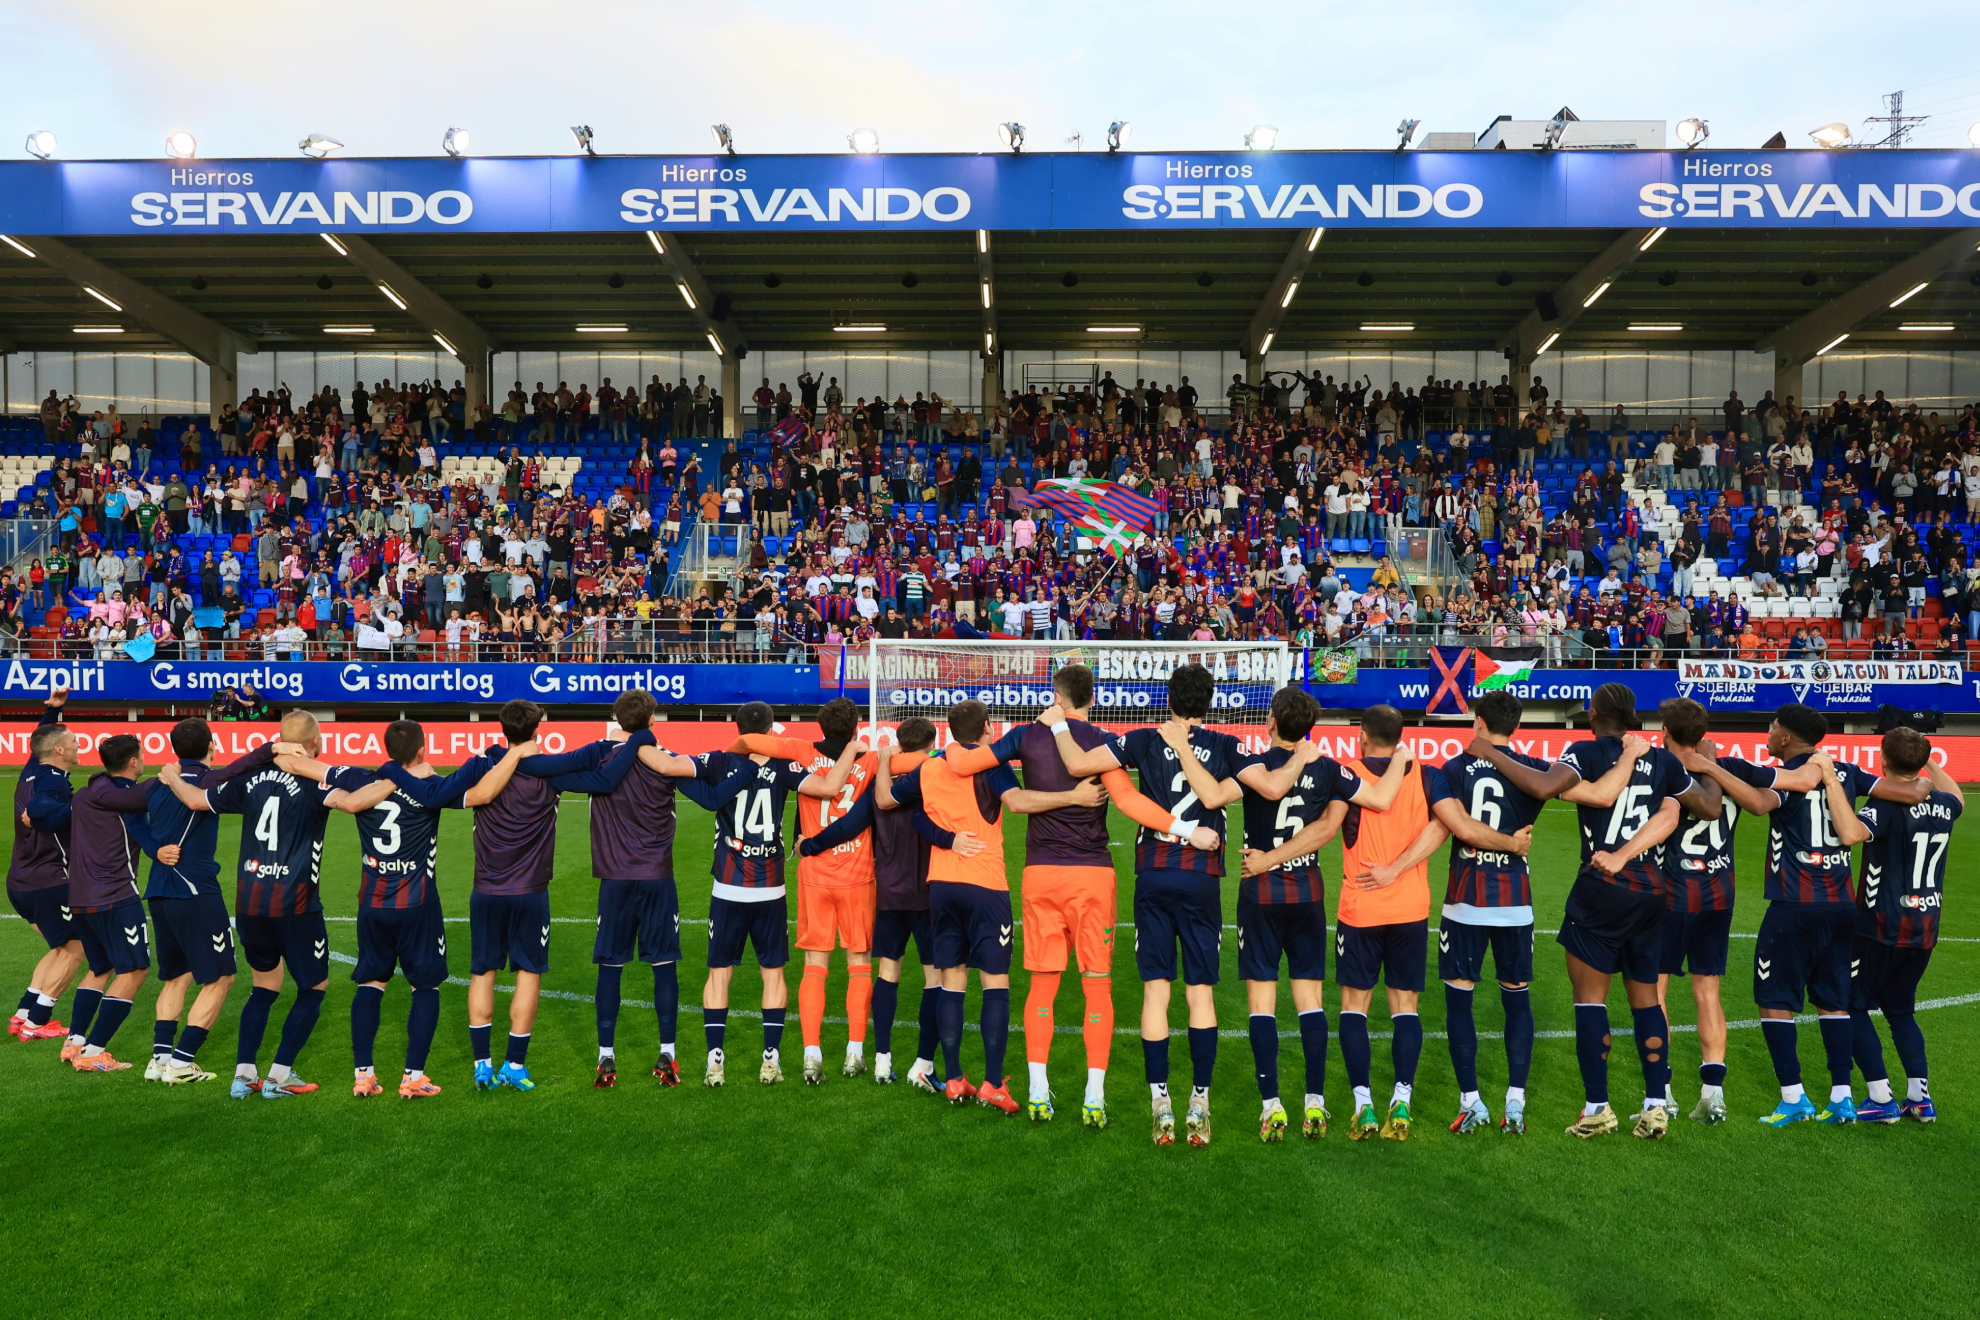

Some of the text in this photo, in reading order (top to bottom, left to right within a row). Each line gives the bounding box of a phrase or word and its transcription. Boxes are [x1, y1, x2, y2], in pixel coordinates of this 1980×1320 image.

[170, 168, 255, 187] Hierros
[661, 164, 748, 183] Hierros
[1165, 160, 1254, 179] Hierros
[1683, 158, 1774, 178] Hierros
[130, 190, 474, 227] SERVANDO
[620, 186, 972, 224] SERVANDO
[1122, 183, 1485, 220] SERVANDO
[3, 660, 105, 692] Azpiri
[993, 650, 1035, 675] 1940
[1834, 663, 1889, 680] LAGUN
[1894, 663, 1960, 681] TALDEA
[187, 666, 304, 697] smartlog
[376, 667, 495, 698] smartlog
[567, 669, 686, 699] smartlog
[734, 788, 775, 842] 14
[1470, 777, 1505, 831] 6
[1604, 784, 1654, 845] 15
[254, 795, 281, 852] 4
[372, 800, 402, 855] 3
[1272, 795, 1305, 850] 5
[378, 858, 417, 875] galys
[741, 844, 777, 858] galys
[1476, 850, 1510, 869] galys
[1911, 831, 1950, 890] 17
[256, 861, 290, 880] galys
